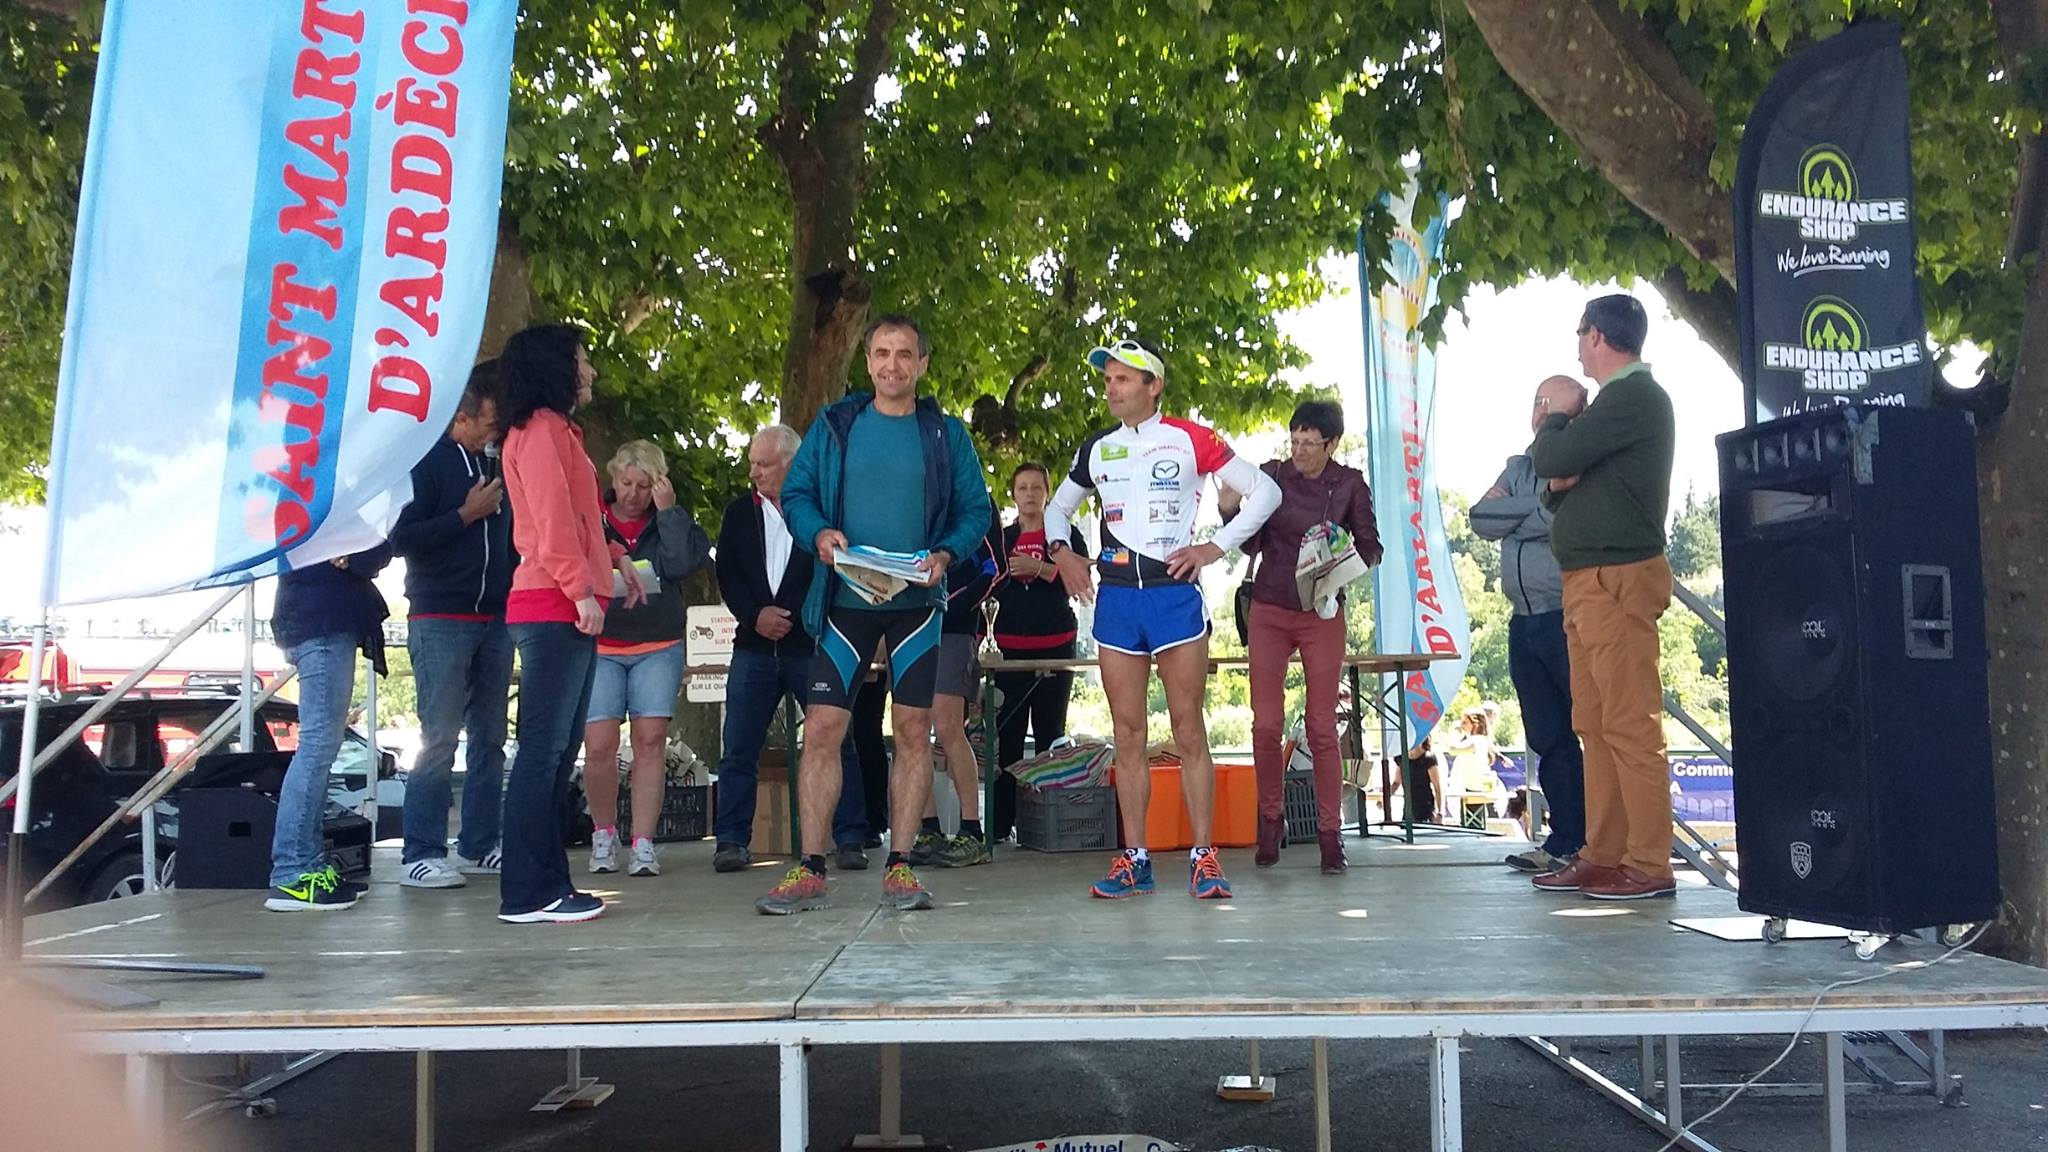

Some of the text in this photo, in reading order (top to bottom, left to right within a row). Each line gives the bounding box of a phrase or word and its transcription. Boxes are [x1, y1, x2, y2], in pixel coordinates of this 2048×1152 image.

[367, 0, 469, 423] D'ARDÈC
[1761, 192, 1908, 222] ENDURANCE
[1800, 217, 1857, 241] SHOP
[1777, 243, 1891, 272] We love Running
[1765, 343, 1921, 371] ENDURANCE
[1804, 369, 1867, 391] SHOP
